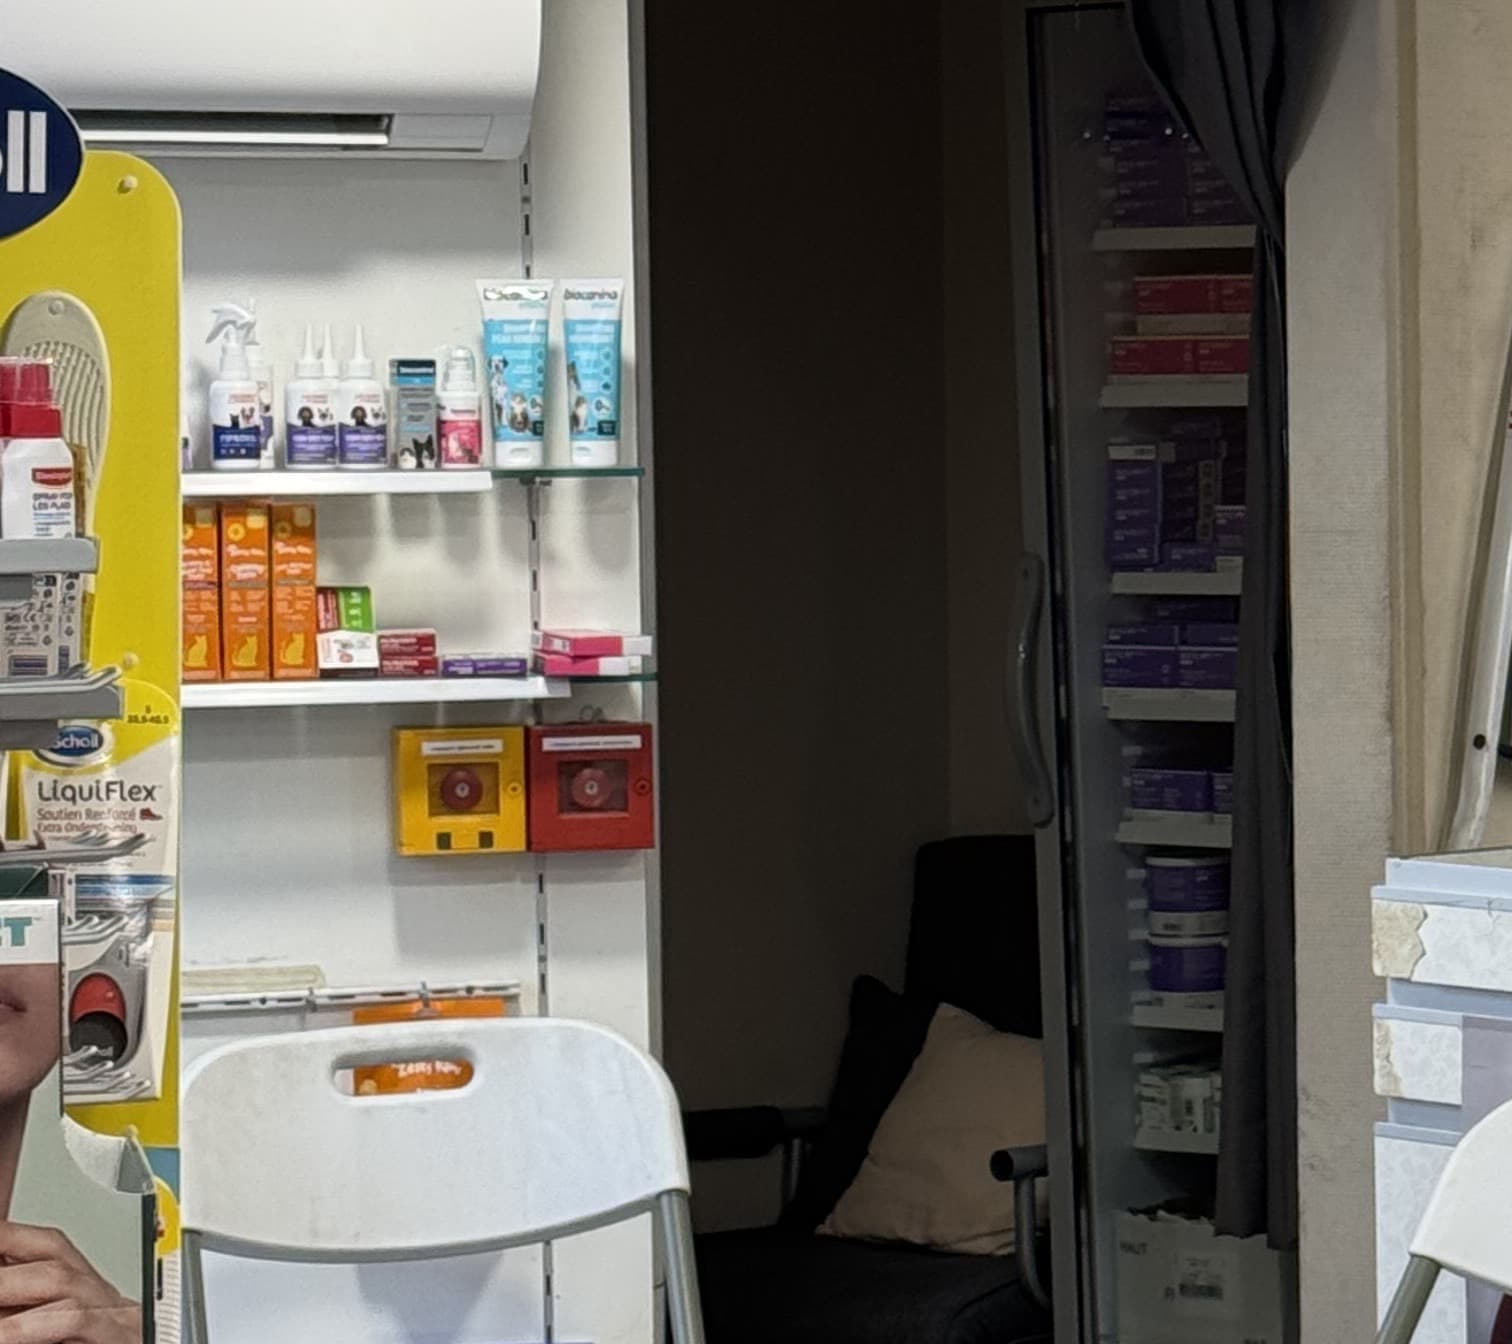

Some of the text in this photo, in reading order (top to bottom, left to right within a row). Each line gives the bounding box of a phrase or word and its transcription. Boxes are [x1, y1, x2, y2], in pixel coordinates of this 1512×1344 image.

[0, 110, 47, 193] ll
[38, 779, 157, 806] LiquiFlex
[37, 808, 83, 821] Soutien
